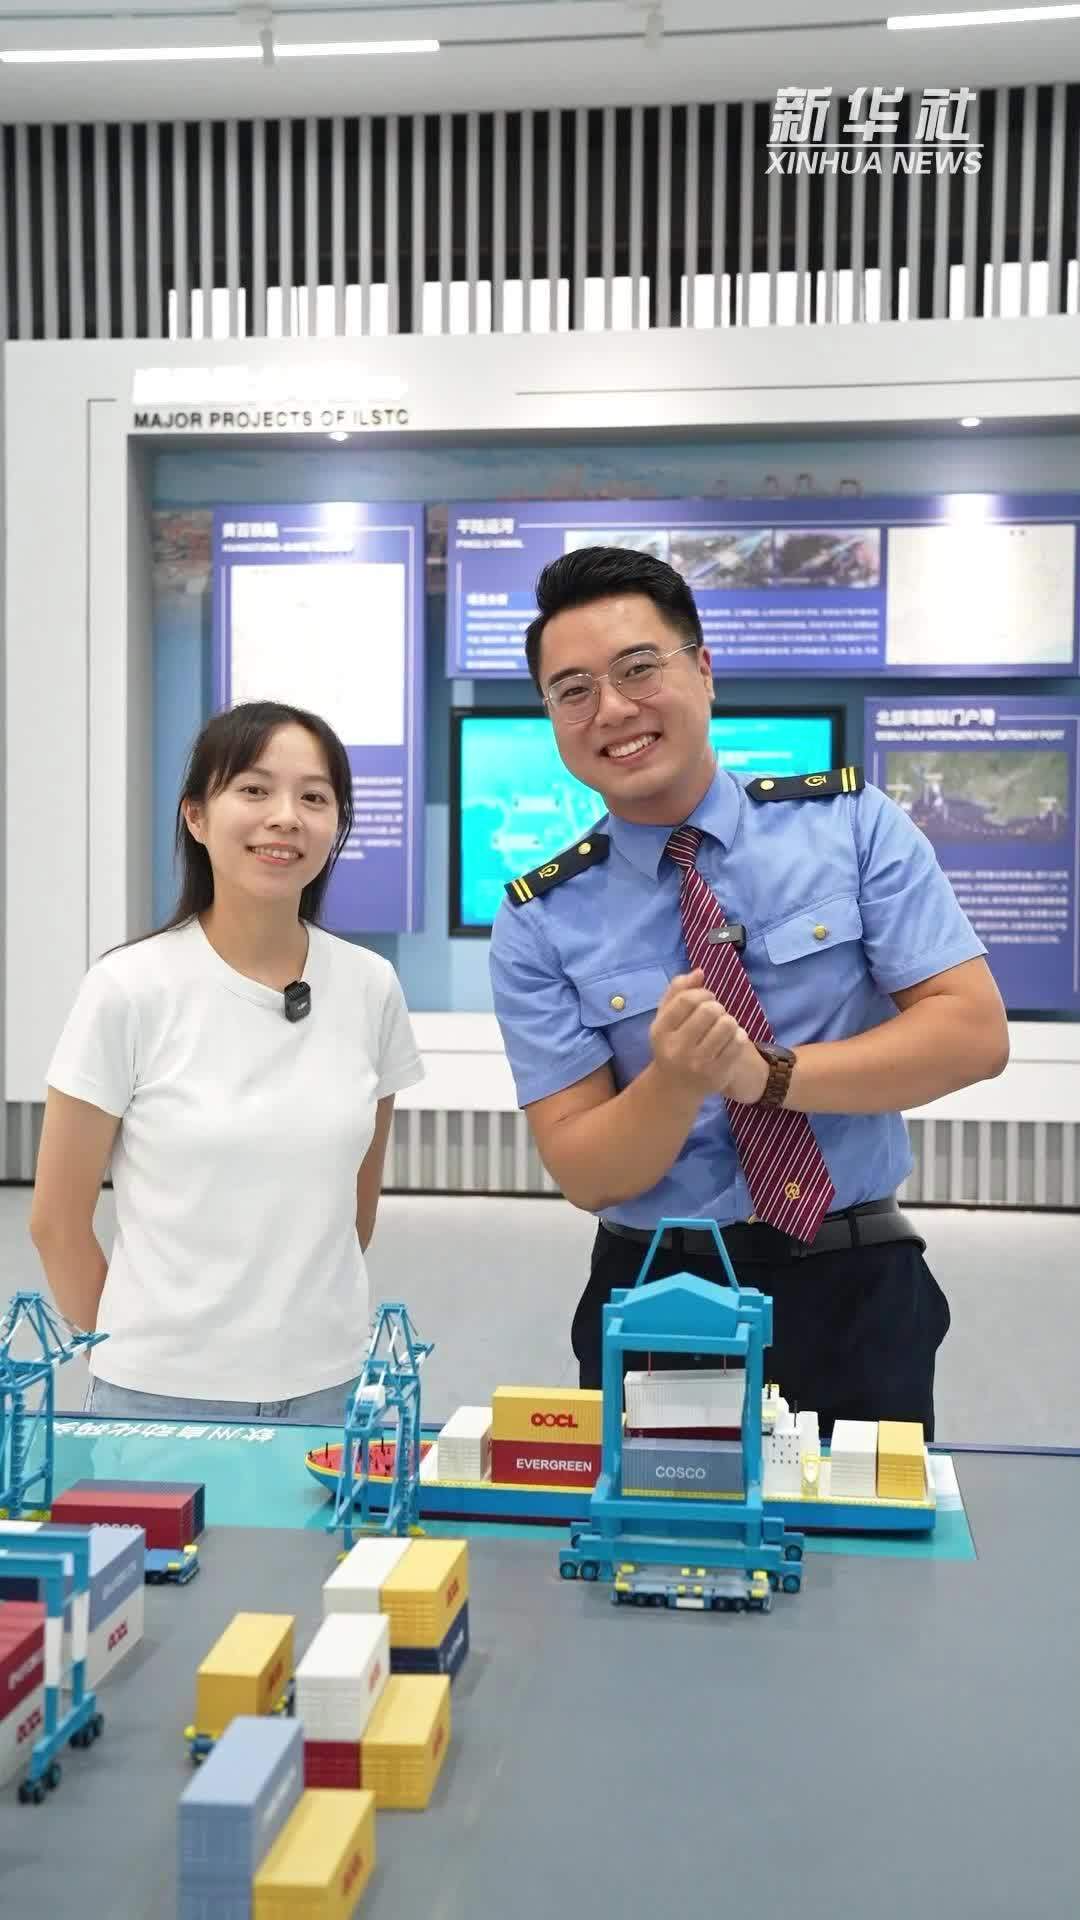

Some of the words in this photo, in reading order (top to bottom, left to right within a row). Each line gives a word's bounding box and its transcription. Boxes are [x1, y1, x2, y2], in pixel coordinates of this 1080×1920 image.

[133, 412, 204, 429] MAJOR
[208, 410, 313, 428] PROJECTS
[320, 410, 346, 426] OF
[353, 409, 410, 426] ILSTC
[531, 1413, 578, 1428] OOCL
[516, 1458, 592, 1472] EVERGREEN
[655, 1465, 706, 1480] COSCO
